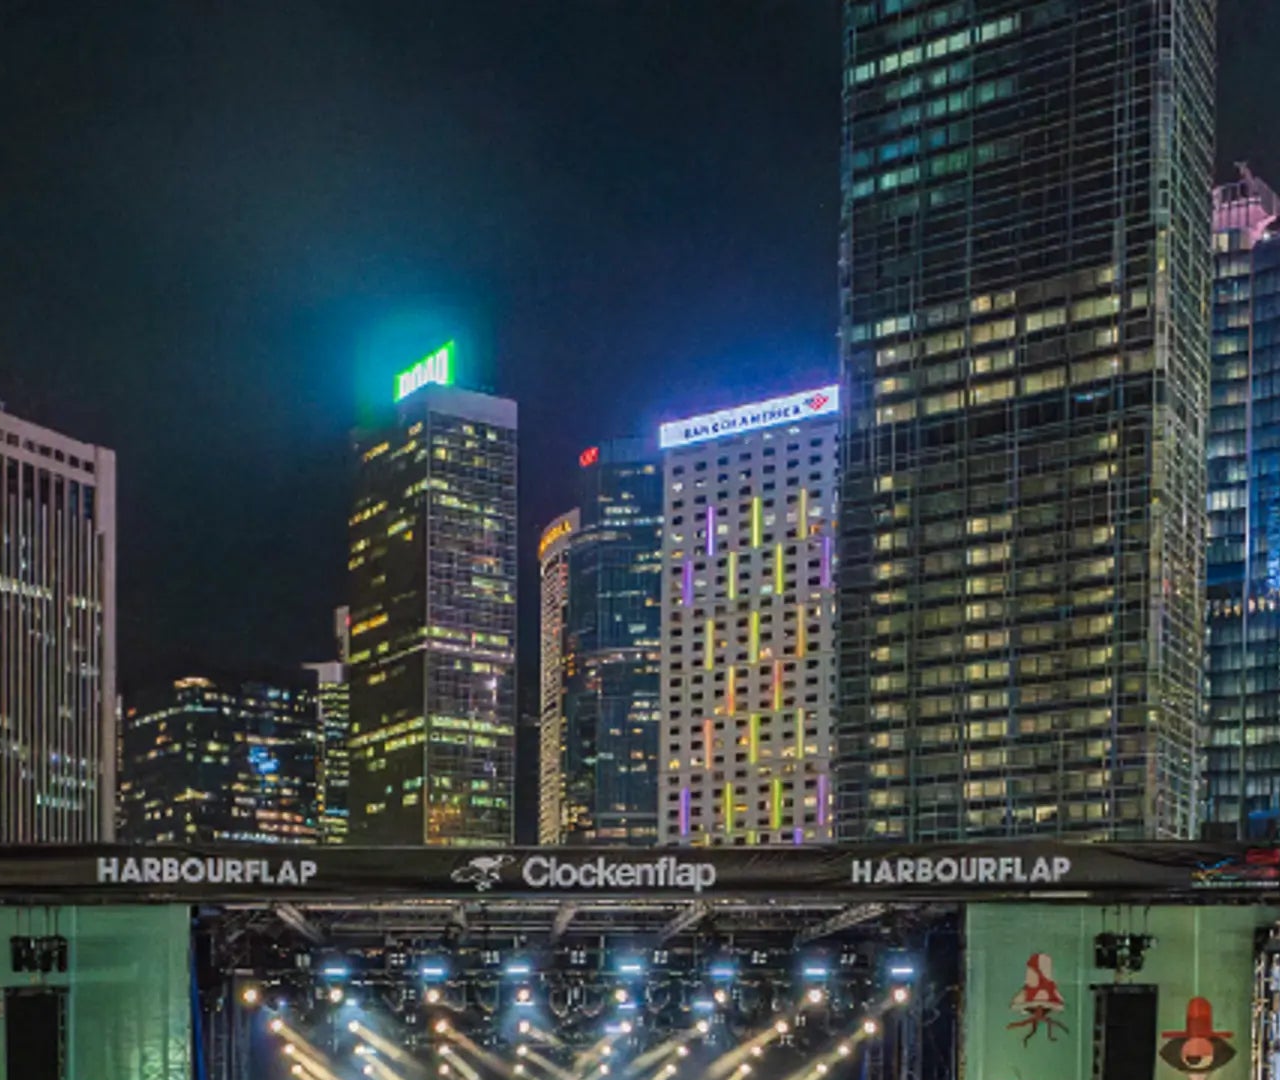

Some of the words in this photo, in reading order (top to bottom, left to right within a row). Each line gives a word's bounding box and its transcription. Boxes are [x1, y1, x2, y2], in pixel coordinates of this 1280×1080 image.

[96, 856, 318, 884] HARBOURFLAP
[522, 855, 717, 893] Clockenflap
[851, 856, 1072, 884] HARBOURFLAP
